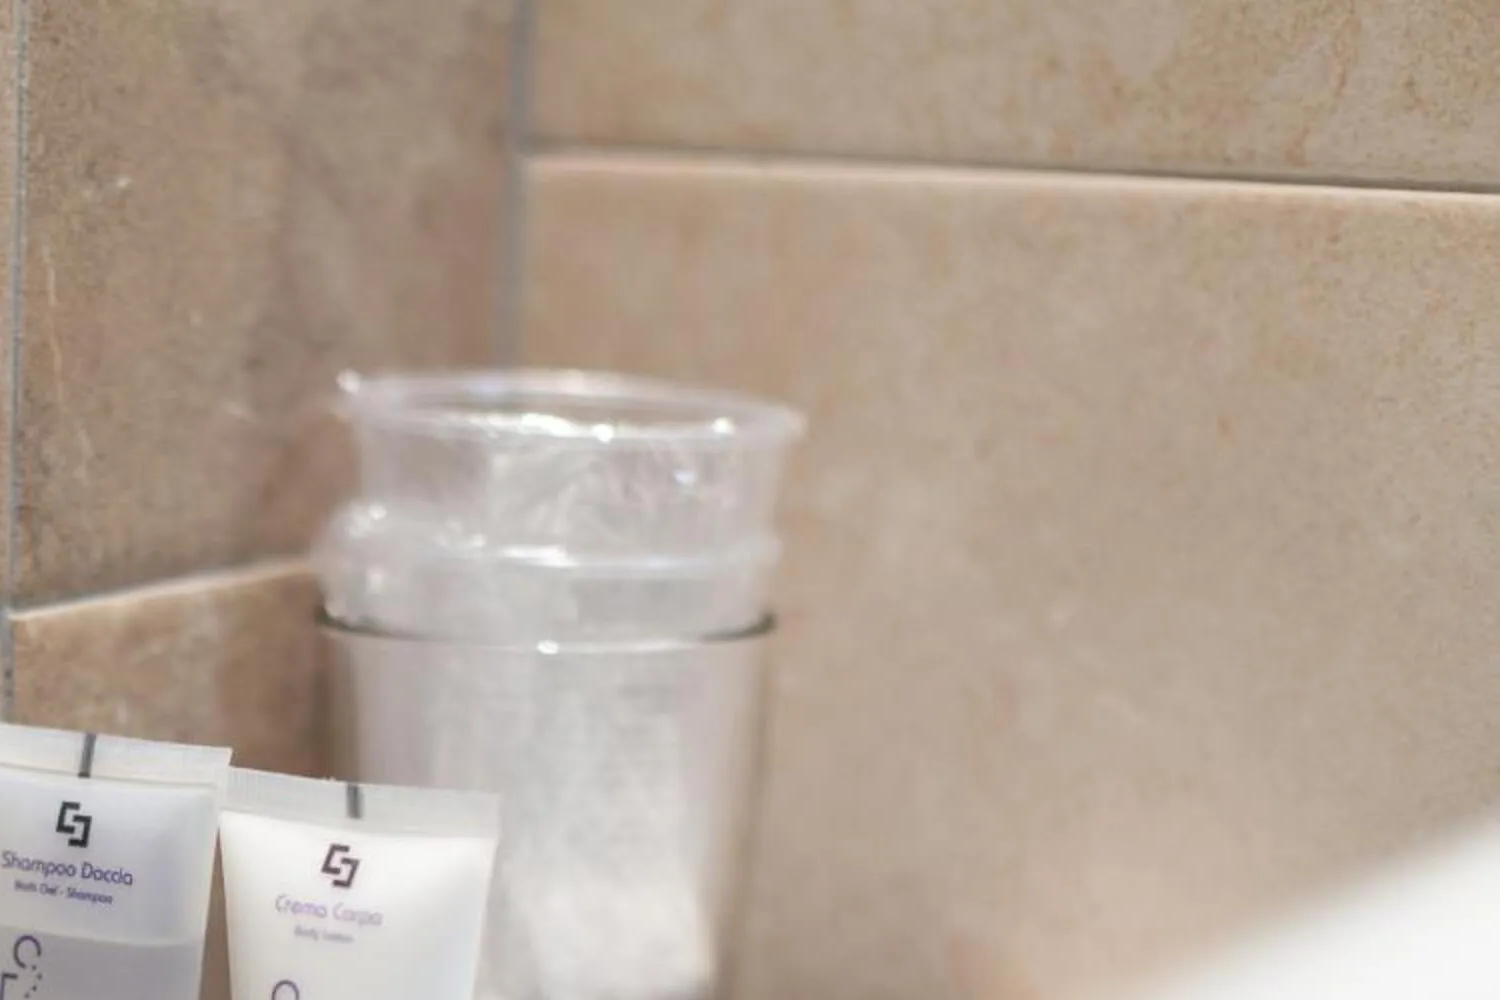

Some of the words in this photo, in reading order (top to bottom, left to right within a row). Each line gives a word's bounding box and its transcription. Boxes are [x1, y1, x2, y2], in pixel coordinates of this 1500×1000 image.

[1, 851, 77, 877] Shampoo
[81, 862, 133, 886] Doccia
[275, 894, 328, 918] Crema
